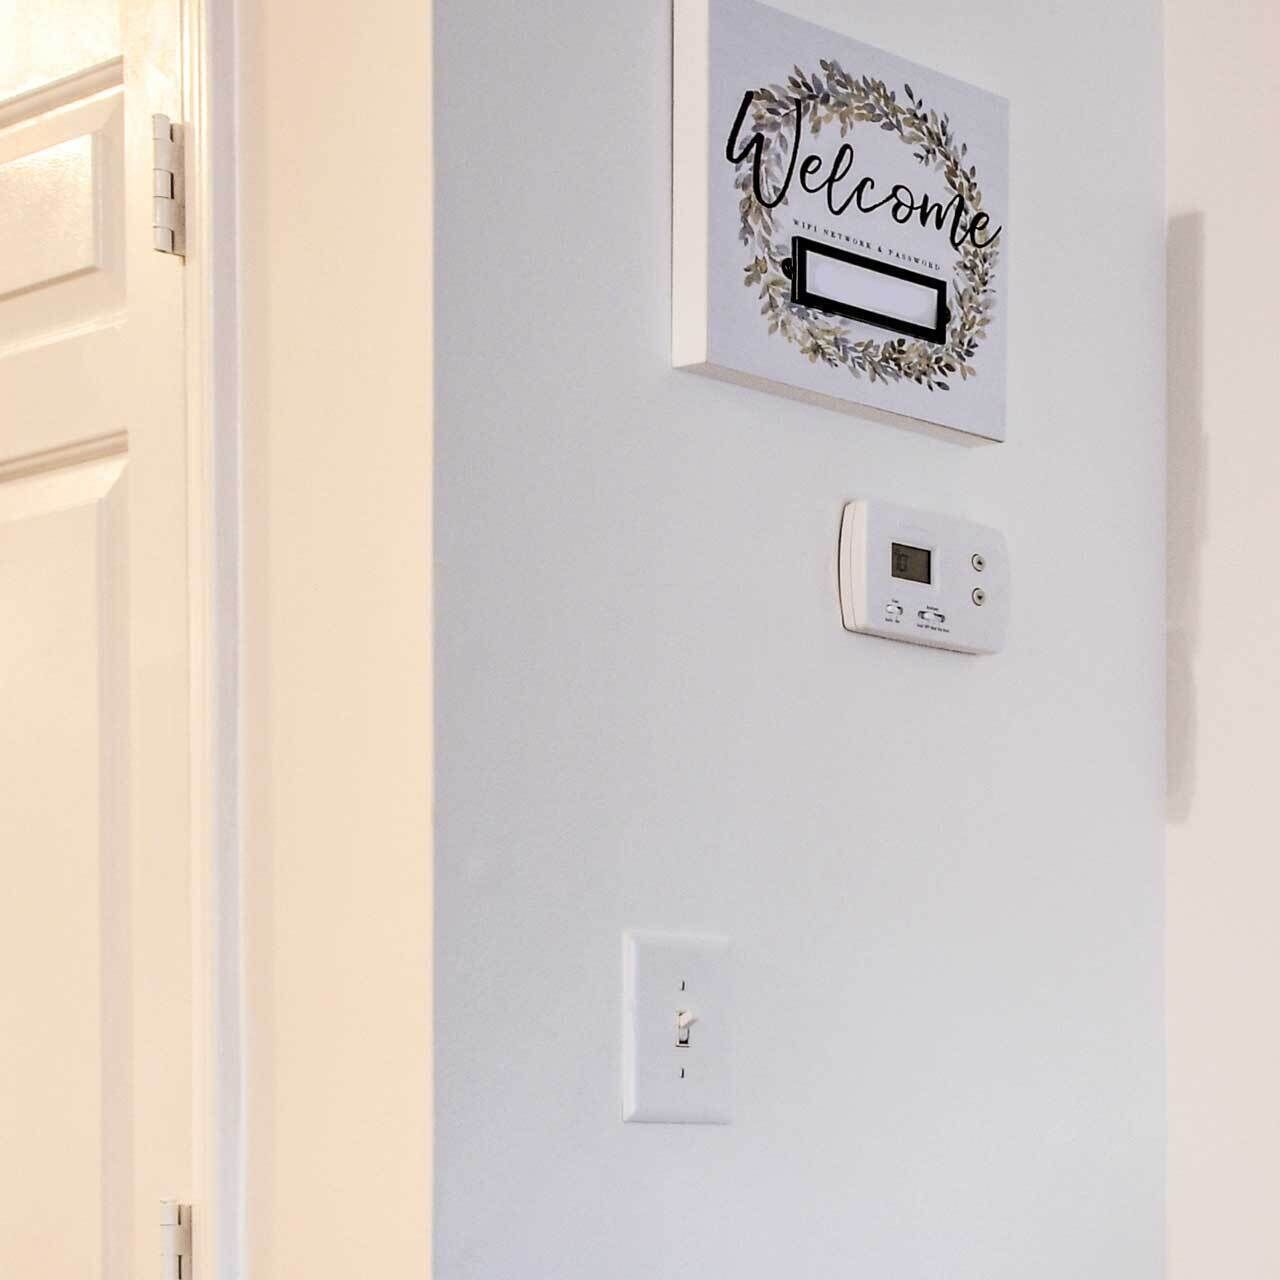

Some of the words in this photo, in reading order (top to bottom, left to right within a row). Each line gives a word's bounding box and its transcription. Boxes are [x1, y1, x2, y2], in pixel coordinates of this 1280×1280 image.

[726, 90, 1001, 249] Welcome
[792, 217, 817, 233] WIFI
[823, 228, 873, 249] NETWORK
[888, 248, 941, 272] PASSWORD
